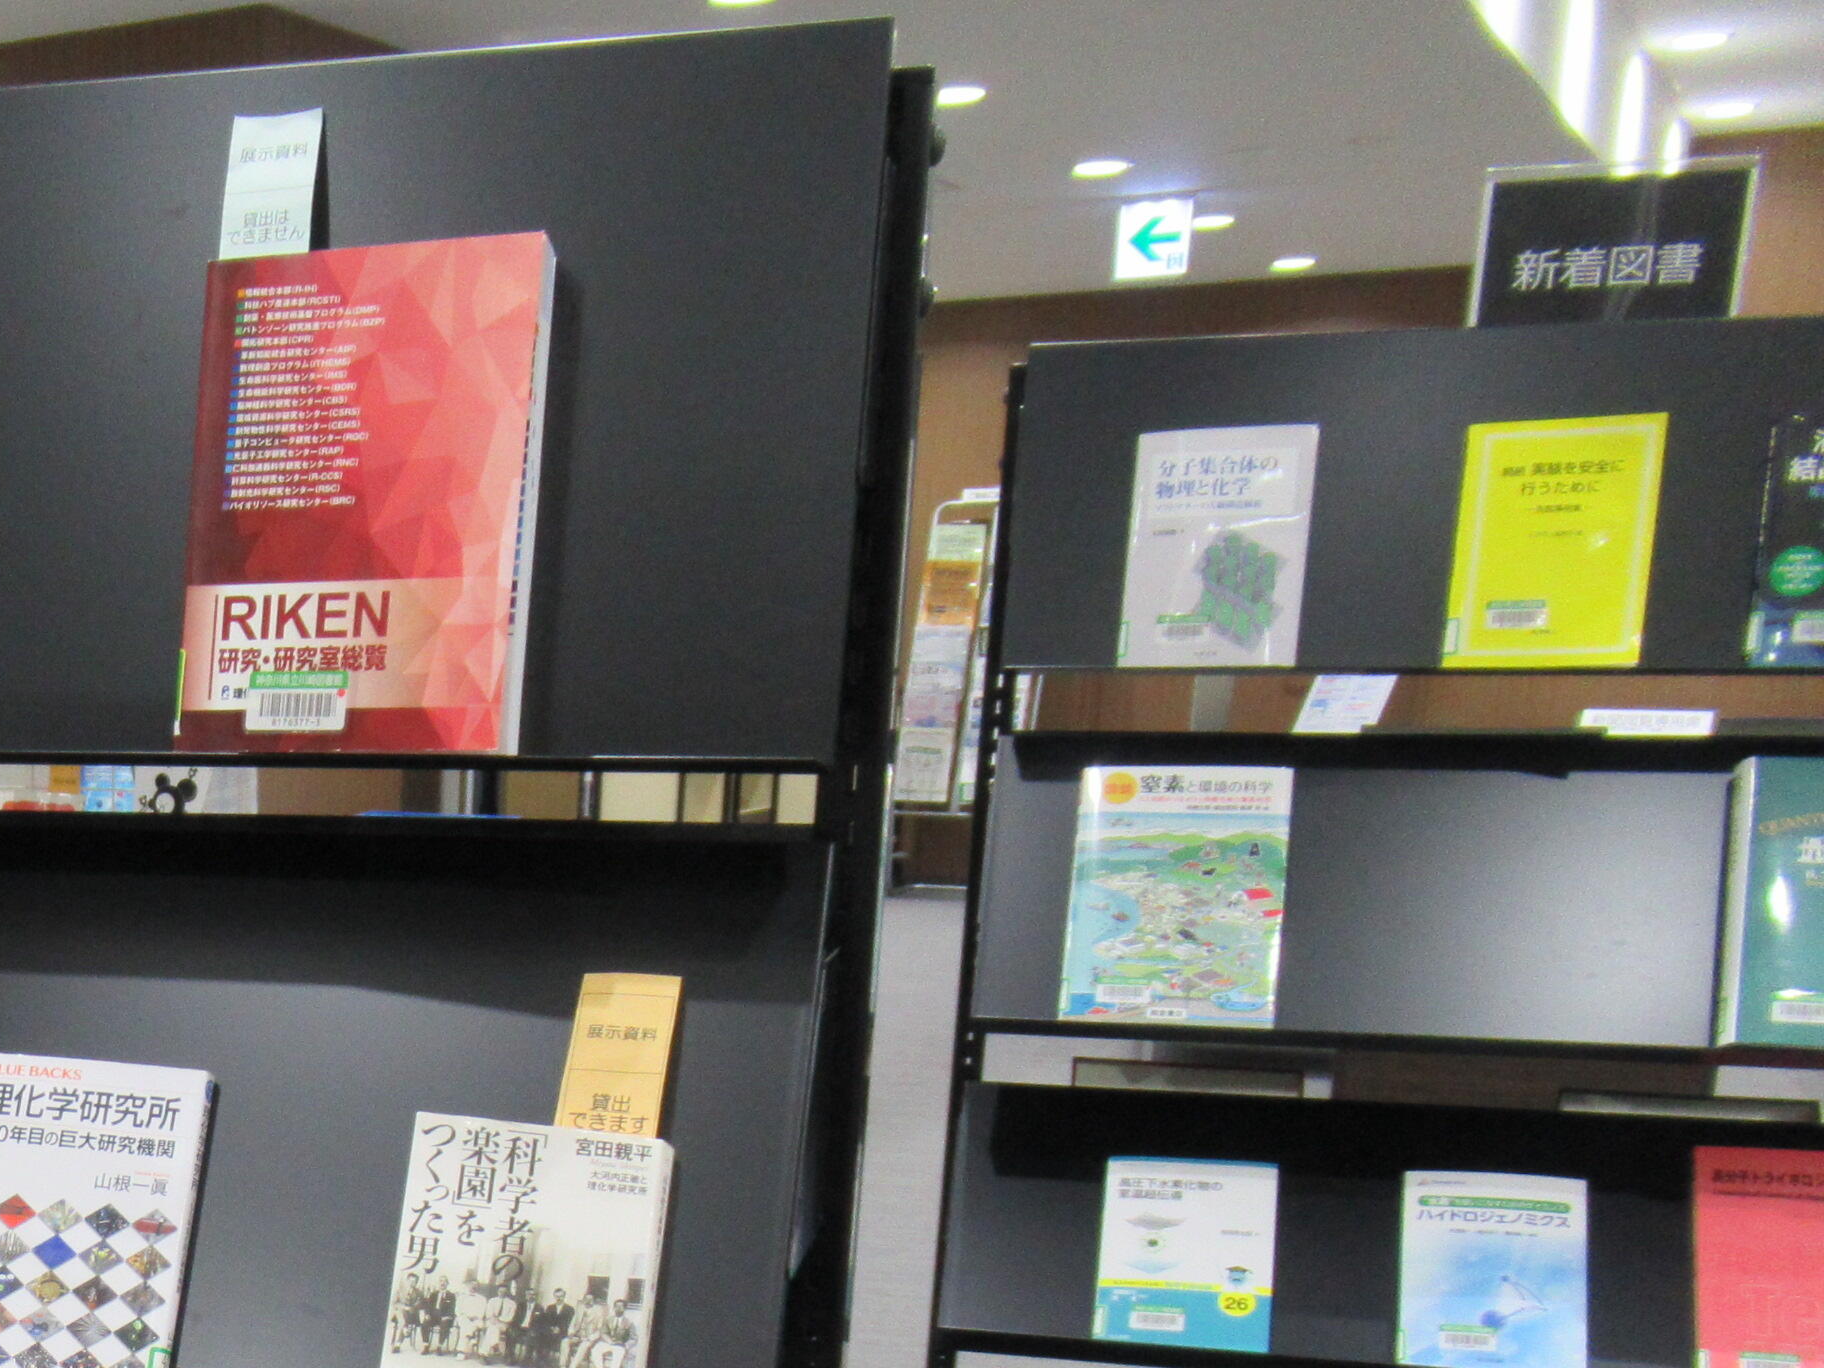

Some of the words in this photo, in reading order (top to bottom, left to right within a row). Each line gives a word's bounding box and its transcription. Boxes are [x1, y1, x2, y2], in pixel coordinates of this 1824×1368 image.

[239, 143, 308, 163] 展示資料
[242, 208, 290, 229] 貸出は
[227, 227, 305, 246] できません
[1512, 241, 1704, 292] 新着図書
[1155, 478, 1251, 499] 物理と化学
[1521, 480, 1600, 496] 行うために
[221, 590, 391, 641] RIKEN
[587, 1024, 657, 1042] 展示資料
[29, 1064, 83, 1082] BACKS
[590, 1092, 632, 1114] 貸出
[568, 1111, 650, 1135] できます
[576, 1137, 653, 1163] 宮田親平
[402, 1120, 458, 1275] つくった男
[1417, 1208, 1572, 1229] ハイドロジェノミクス
[1224, 1296, 1250, 1311] 26
